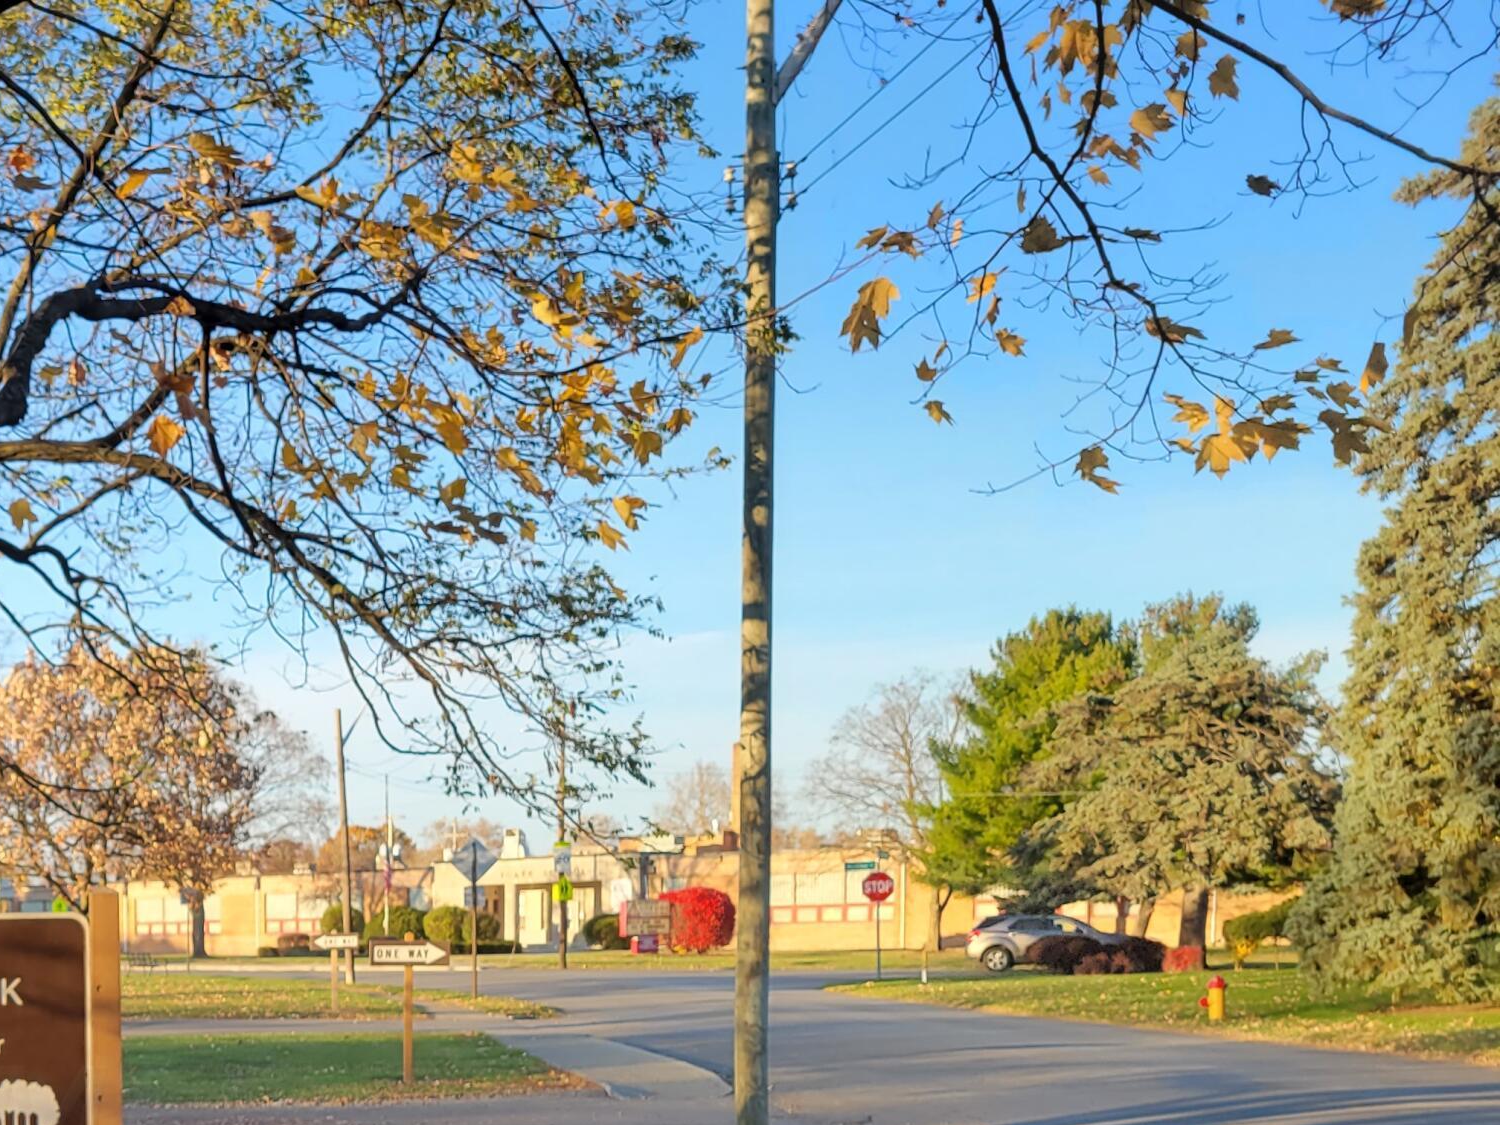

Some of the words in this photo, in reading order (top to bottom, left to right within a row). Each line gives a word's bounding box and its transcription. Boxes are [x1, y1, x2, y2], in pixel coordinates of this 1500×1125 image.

[864, 879, 893, 894] STOP
[375, 949, 400, 960] ONE
[407, 948, 430, 959] WAY
